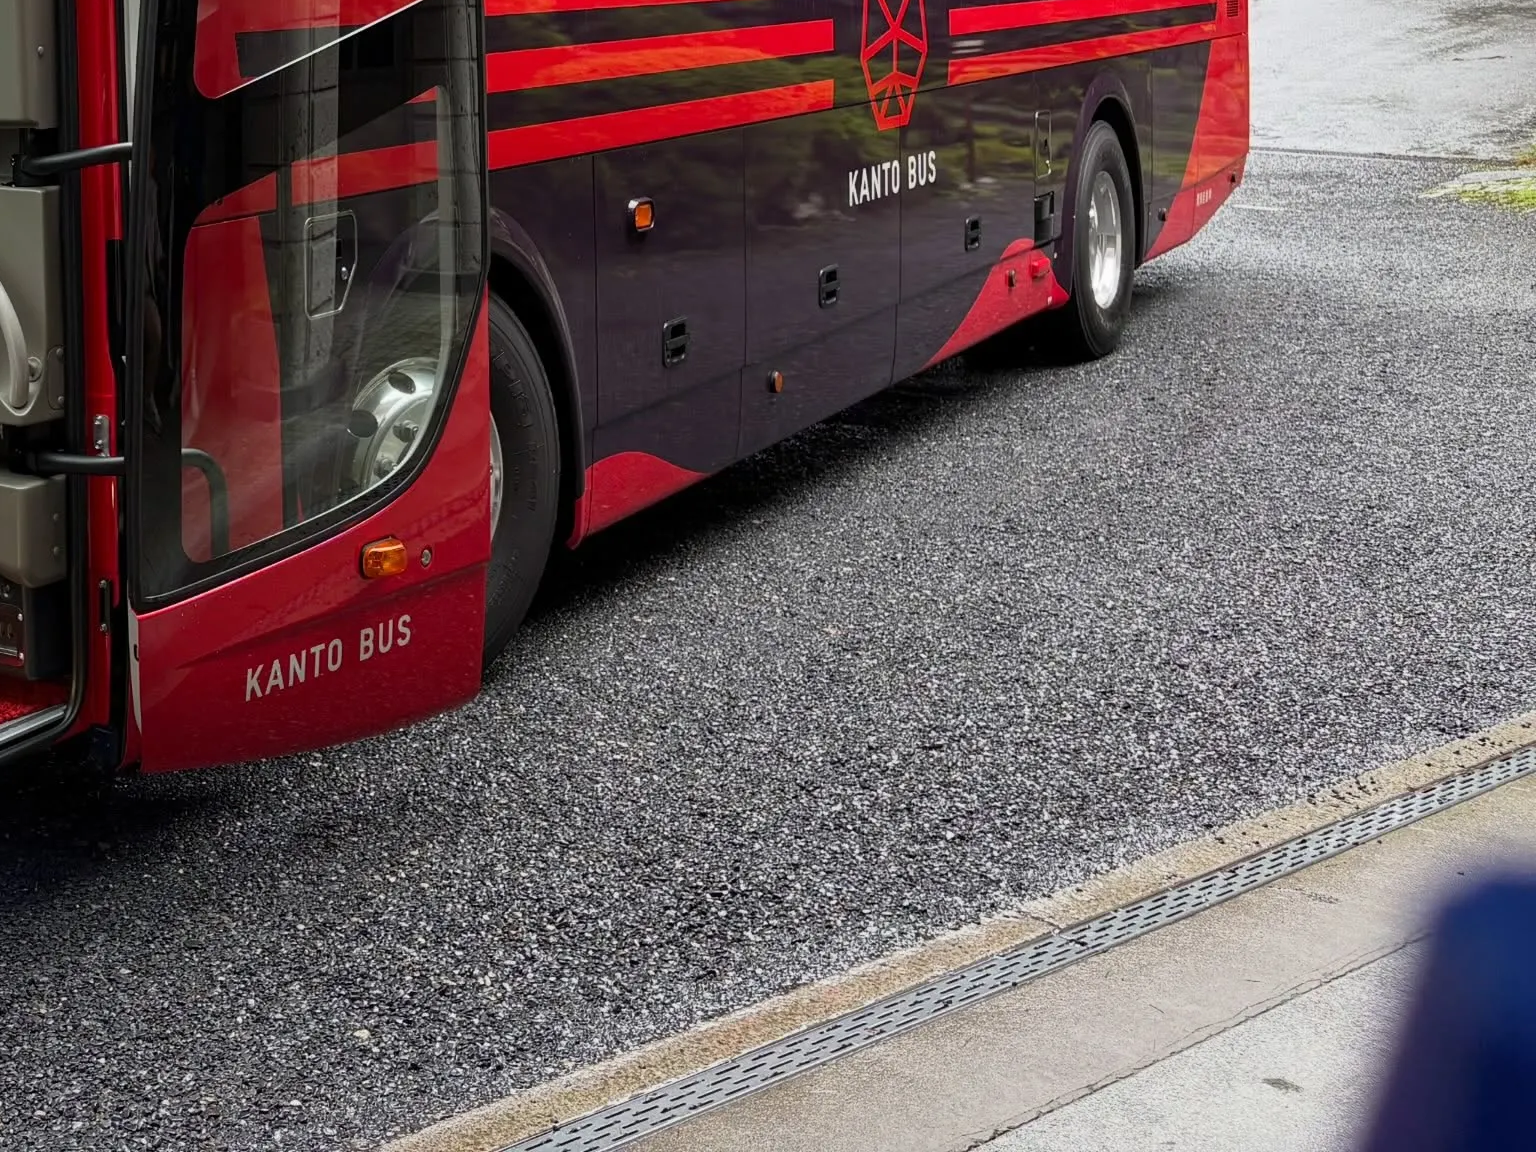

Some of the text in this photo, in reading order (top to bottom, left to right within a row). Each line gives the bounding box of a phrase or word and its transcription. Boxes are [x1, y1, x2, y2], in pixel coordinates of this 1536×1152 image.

[848, 150, 937, 208] KANTO BUS
[245, 613, 412, 703] KANTO BUS
